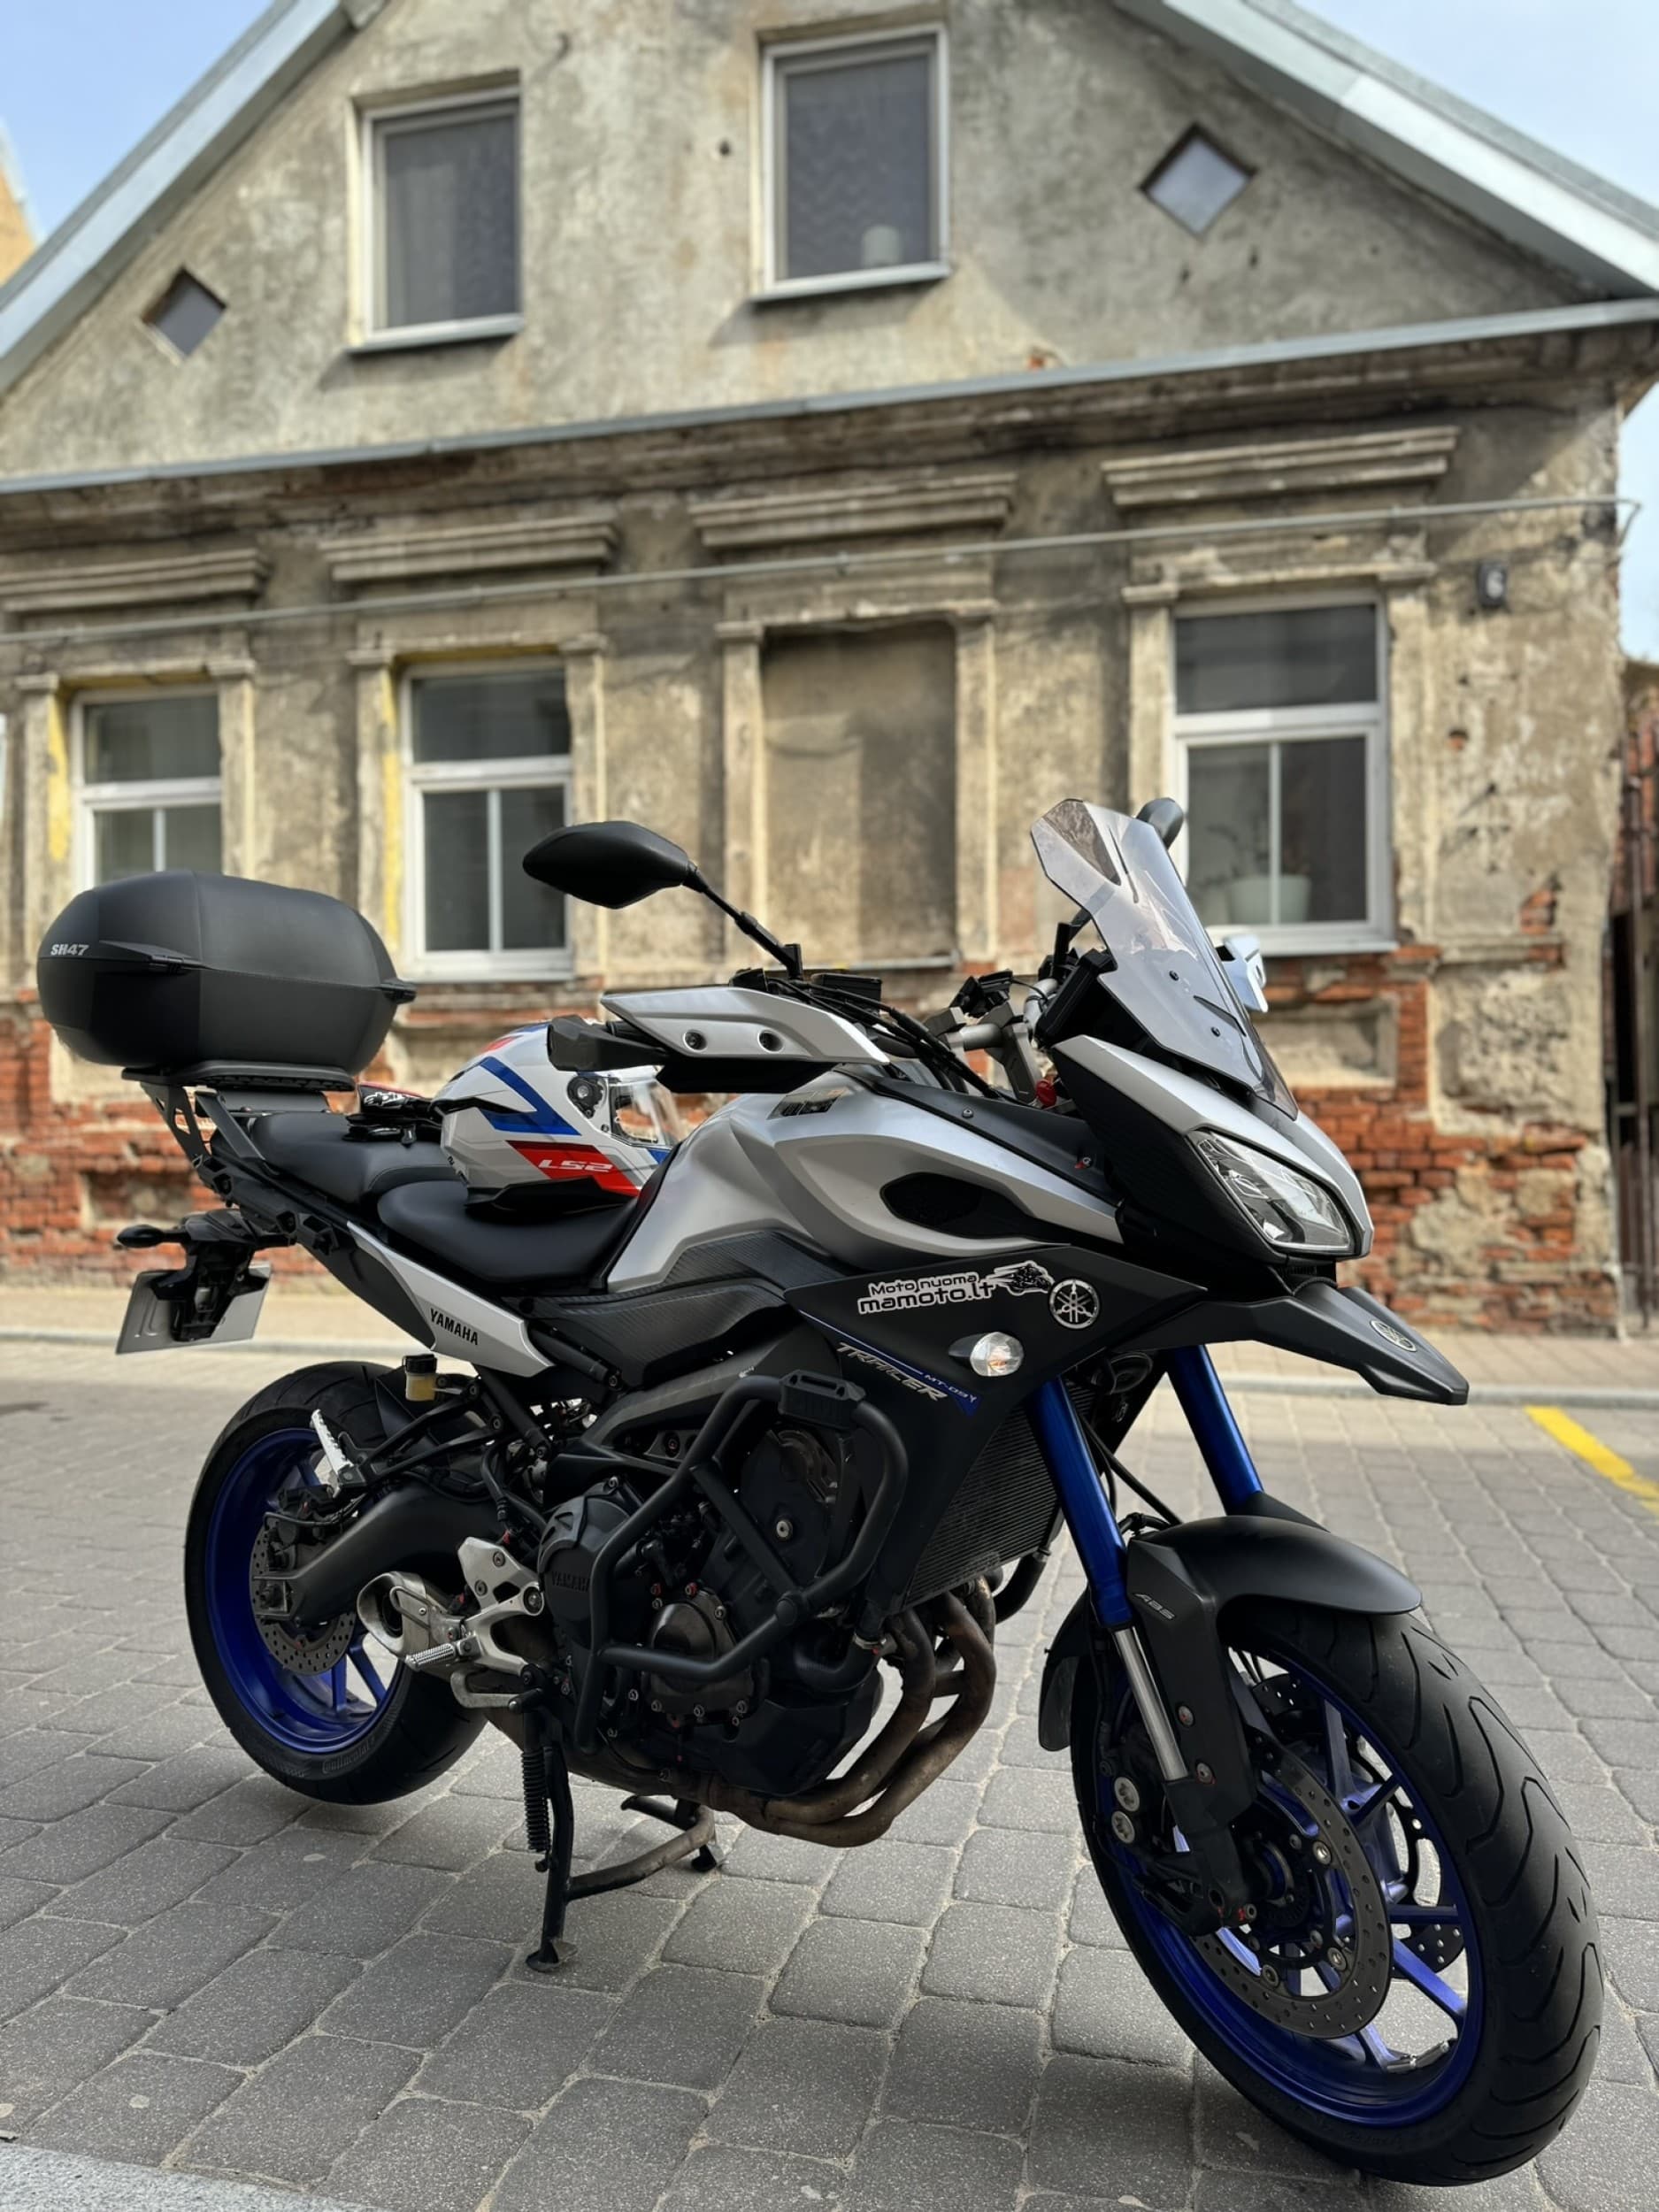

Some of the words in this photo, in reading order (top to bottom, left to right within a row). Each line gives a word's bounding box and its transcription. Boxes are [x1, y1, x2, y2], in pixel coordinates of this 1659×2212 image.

[50, 943, 89, 956] SH47
[538, 1160, 613, 1172] LS2
[860, 1281, 994, 1312] mamoto.lt
[871, 1282, 916, 1295] Moto
[919, 1275, 977, 1288] nuoma
[431, 1308, 478, 1345] YAMAHA
[837, 1342, 948, 1401] TRACER
[552, 1571, 590, 1592] YAMAH
[1135, 1594, 1175, 1619] ABS
